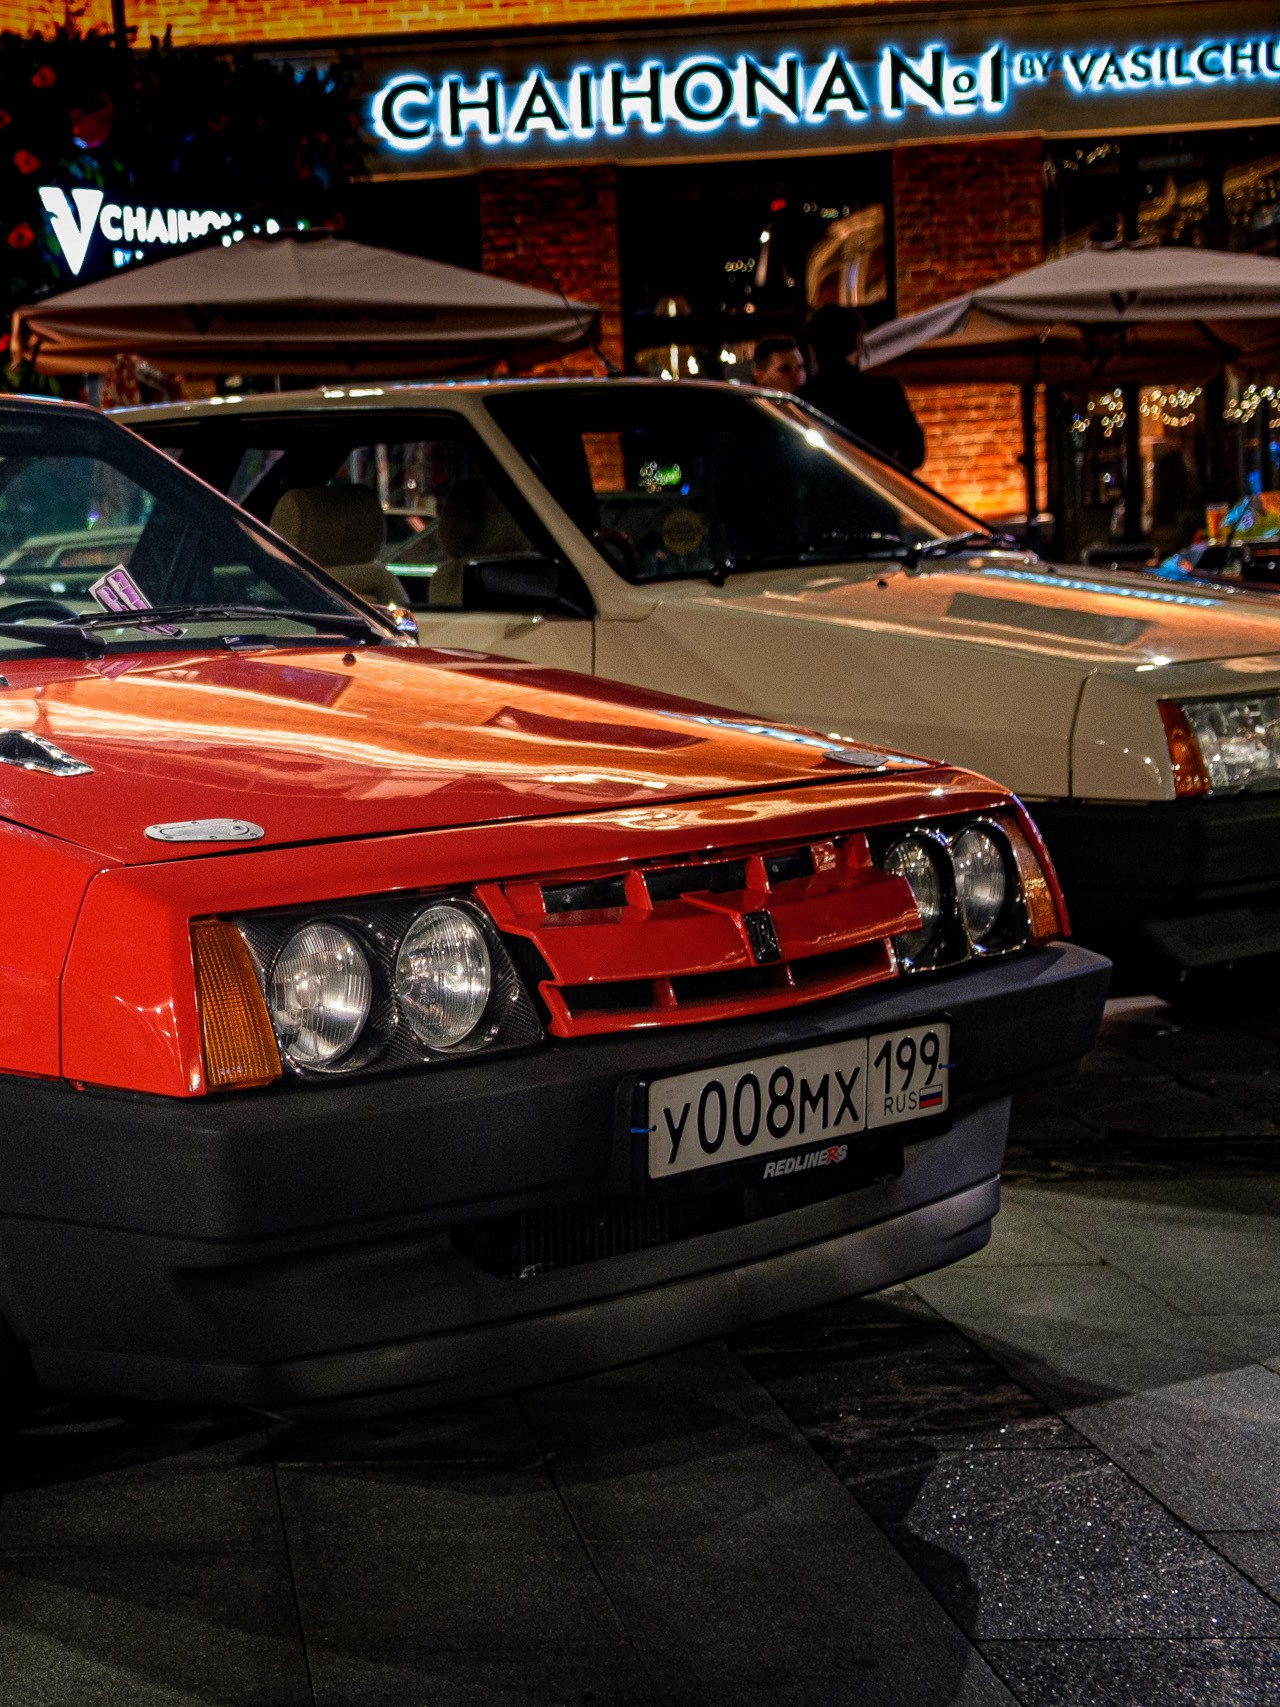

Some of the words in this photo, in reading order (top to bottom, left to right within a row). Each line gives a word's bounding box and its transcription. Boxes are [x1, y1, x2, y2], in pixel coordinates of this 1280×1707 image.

[380, 53, 869, 140] CHAIHONA
[1019, 54, 1054, 79] BY
[874, 1031, 940, 1094] 199
[884, 1091, 918, 1116] RUS
[763, 1144, 848, 1179] REDLINERS
